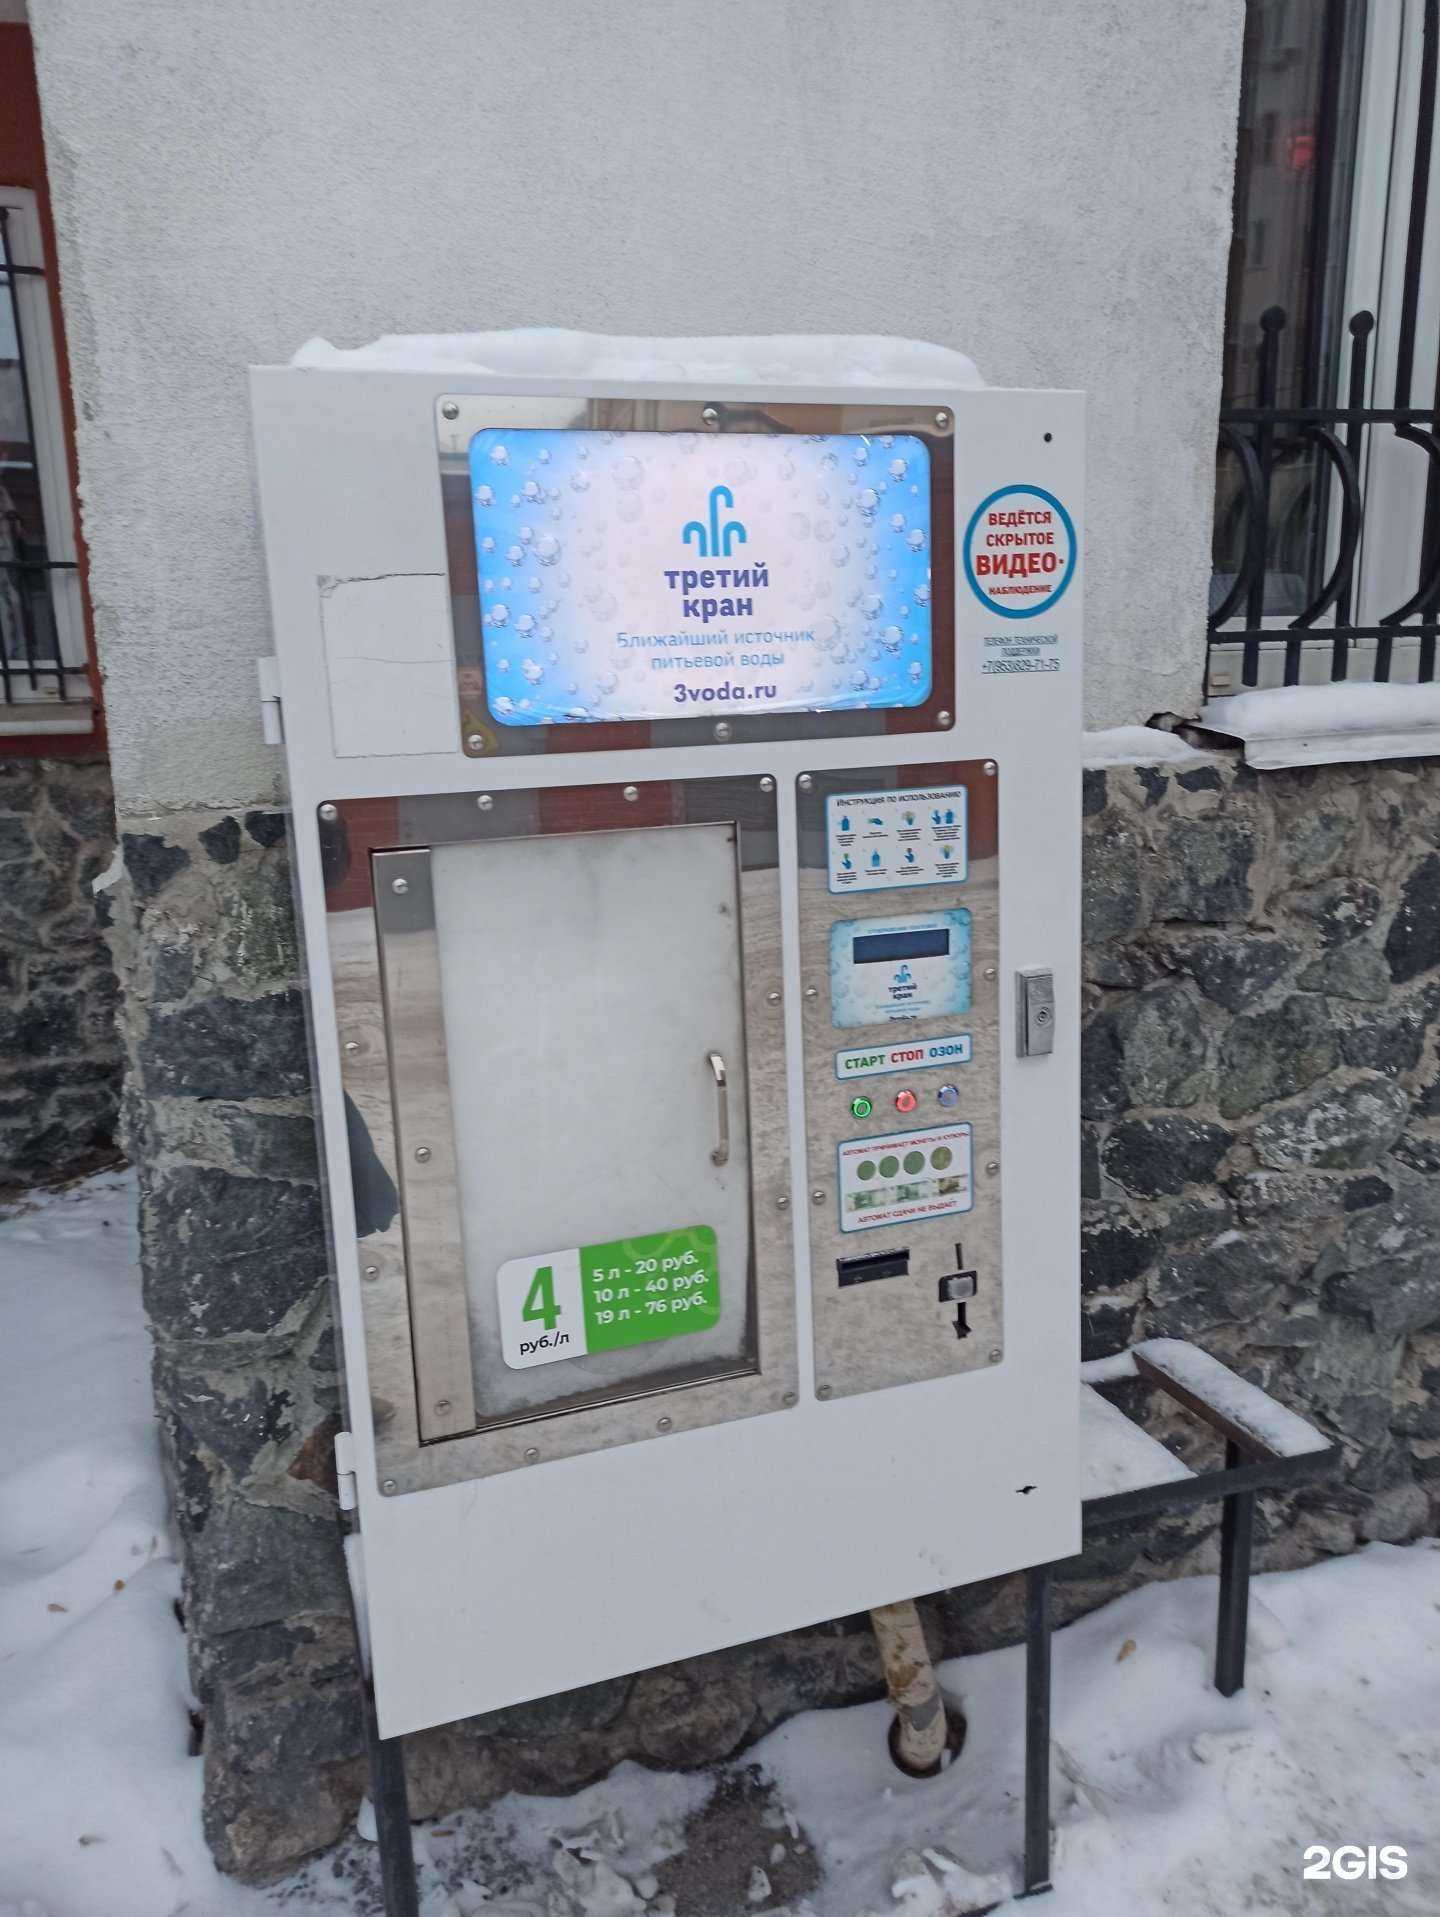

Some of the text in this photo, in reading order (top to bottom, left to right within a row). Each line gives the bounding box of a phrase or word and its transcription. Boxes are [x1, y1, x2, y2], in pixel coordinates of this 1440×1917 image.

[988, 510, 1052, 527] ВЕДЁТСЯ
[986, 532, 1054, 547] СКРЫТОЕ
[664, 562, 769, 595] третий
[988, 584, 1052, 595] НАБЛЮДЕНИЕ
[683, 597, 753, 623] кран
[616, 629, 815, 648] Ближайший источник
[651, 652, 785, 670] питьевой воды
[674, 681, 777, 702] 3voda.ru
[844, 1043, 963, 1070] СТАРТ СТОП ОЗОН
[592, 1268, 604, 1283] 5
[608, 1267, 621, 1280] л
[635, 1258, 657, 1275] 20
[661, 1250, 699, 1272] руб.
[522, 1266, 561, 1331] 4
[594, 1288, 612, 1304] 10
[617, 1287, 630, 1300] л
[645, 1277, 668, 1293] 40
[673, 1269, 709, 1291] руб.
[595, 1309, 614, 1325] 19
[617, 1307, 630, 1320] л
[645, 1299, 667, 1315] 76
[672, 1291, 708, 1312] руб.
[519, 1331, 570, 1356] руб./л
